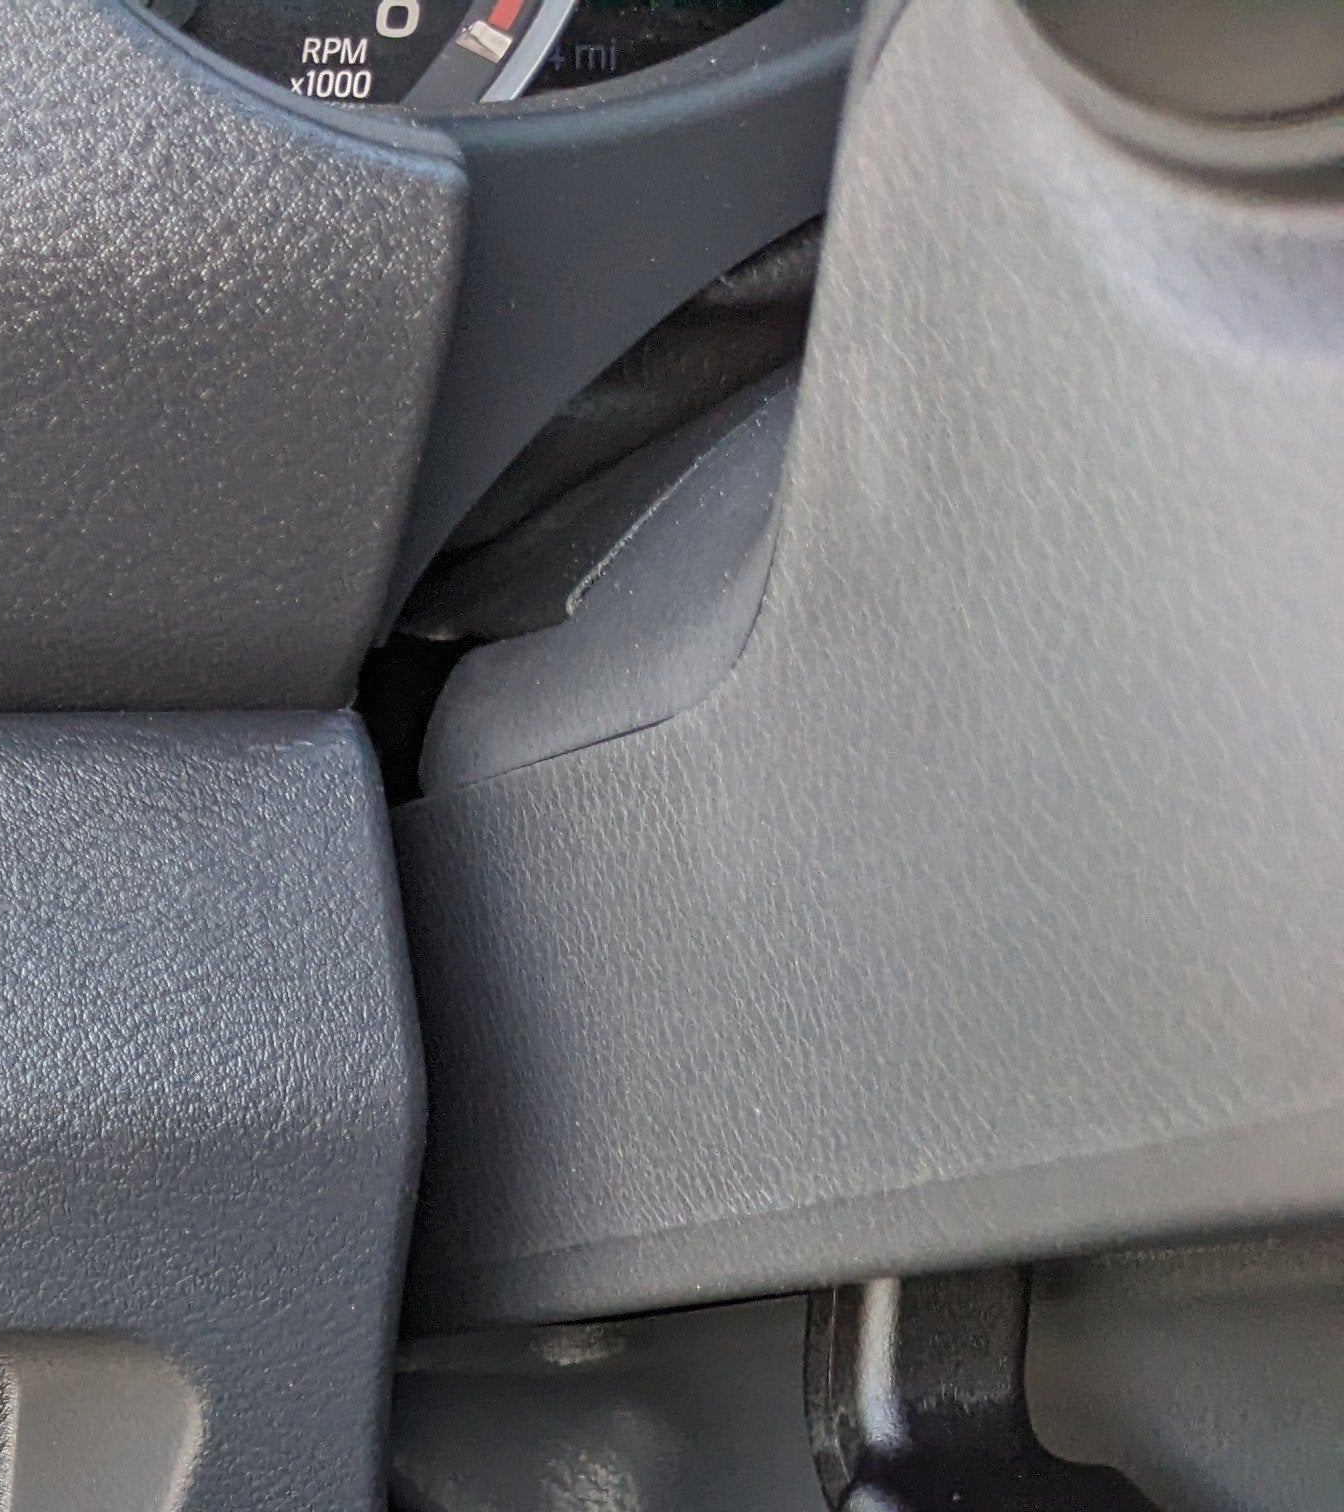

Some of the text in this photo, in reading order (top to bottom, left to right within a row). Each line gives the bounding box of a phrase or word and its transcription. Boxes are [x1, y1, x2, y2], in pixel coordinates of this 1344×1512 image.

[301, 36, 368, 65] RPM
[575, 37, 616, 71] mi
[290, 69, 372, 99] x1000
